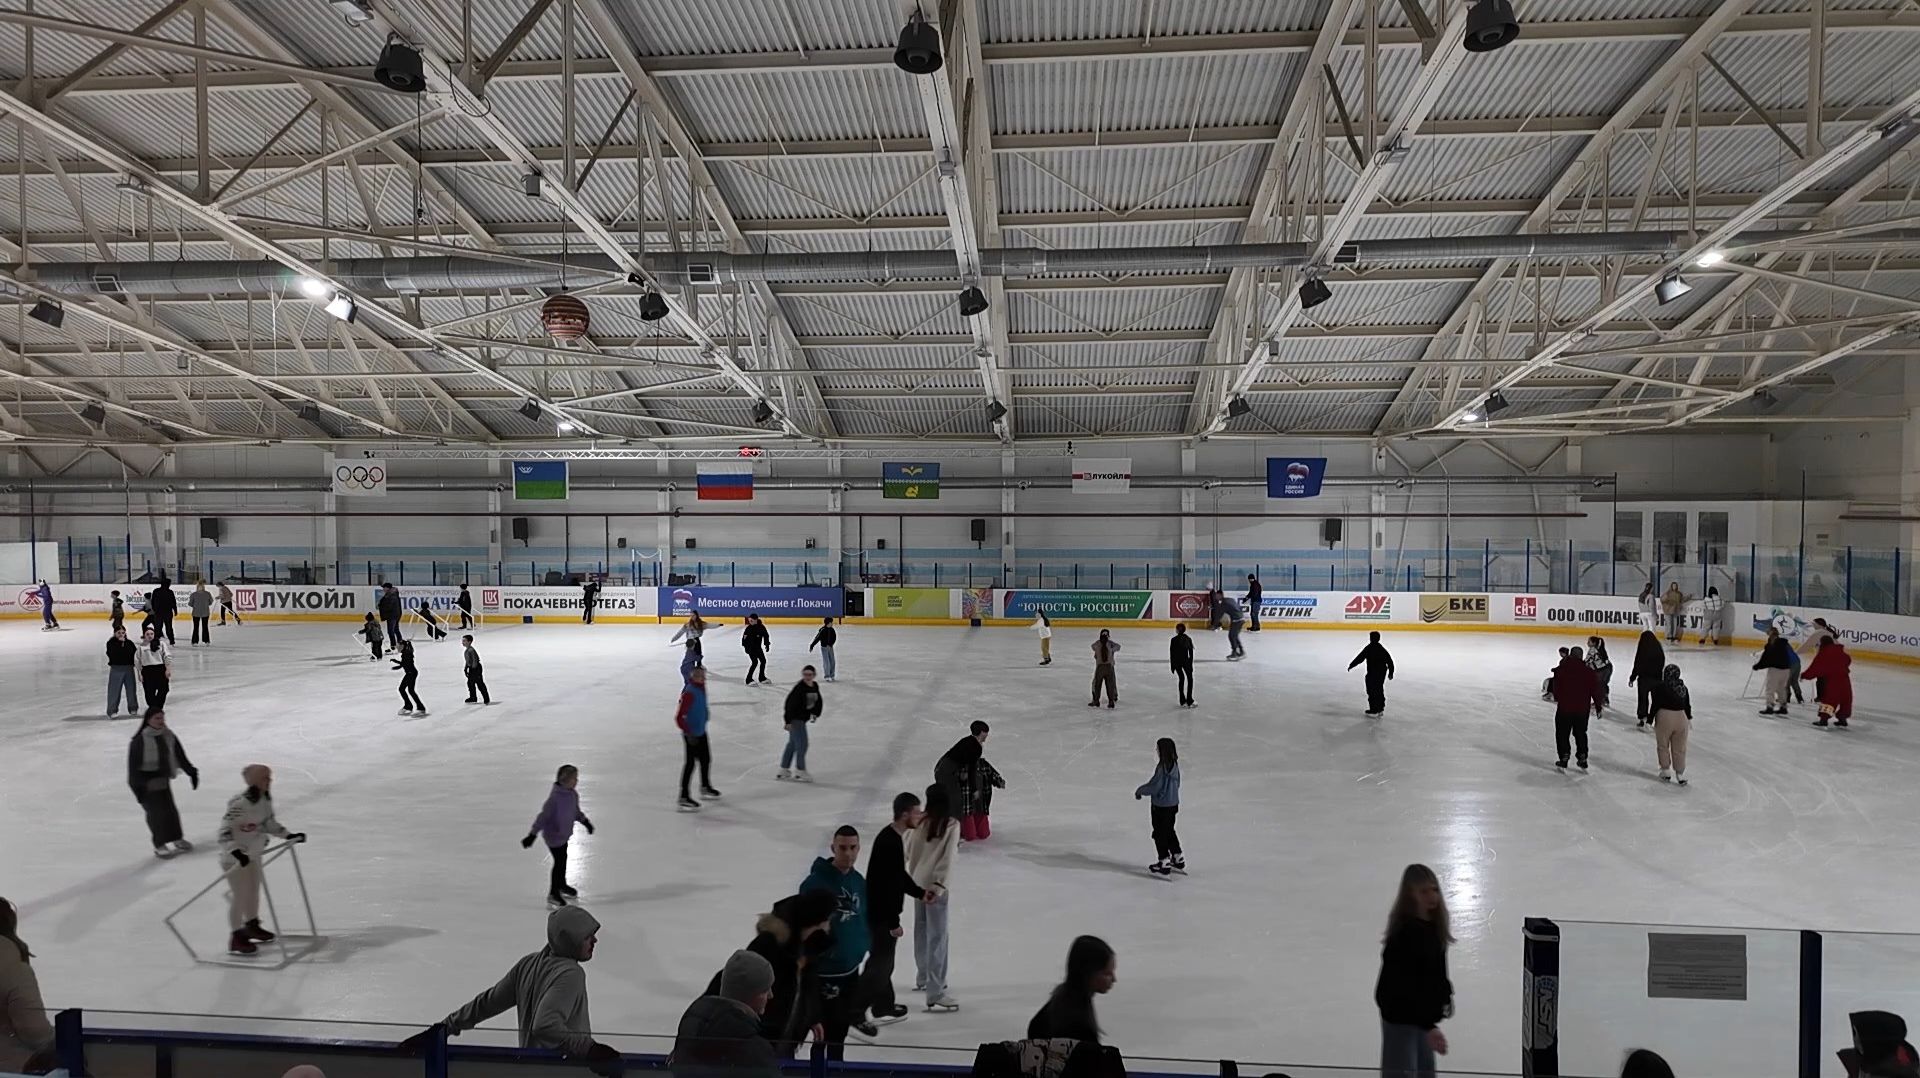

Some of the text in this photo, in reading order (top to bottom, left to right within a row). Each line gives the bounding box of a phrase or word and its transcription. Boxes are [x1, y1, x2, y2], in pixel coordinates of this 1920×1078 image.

[260, 588, 355, 609] ЛУКОЙЛ
[698, 597, 832, 609] Местное отделение г.Покачи
[1449, 598, 1486, 611] БКЕ
[1080, 602, 1135, 613] РОССИИ"
[1260, 607, 1313, 617] ЕСТНИК
[1547, 608, 1575, 622] ООО
